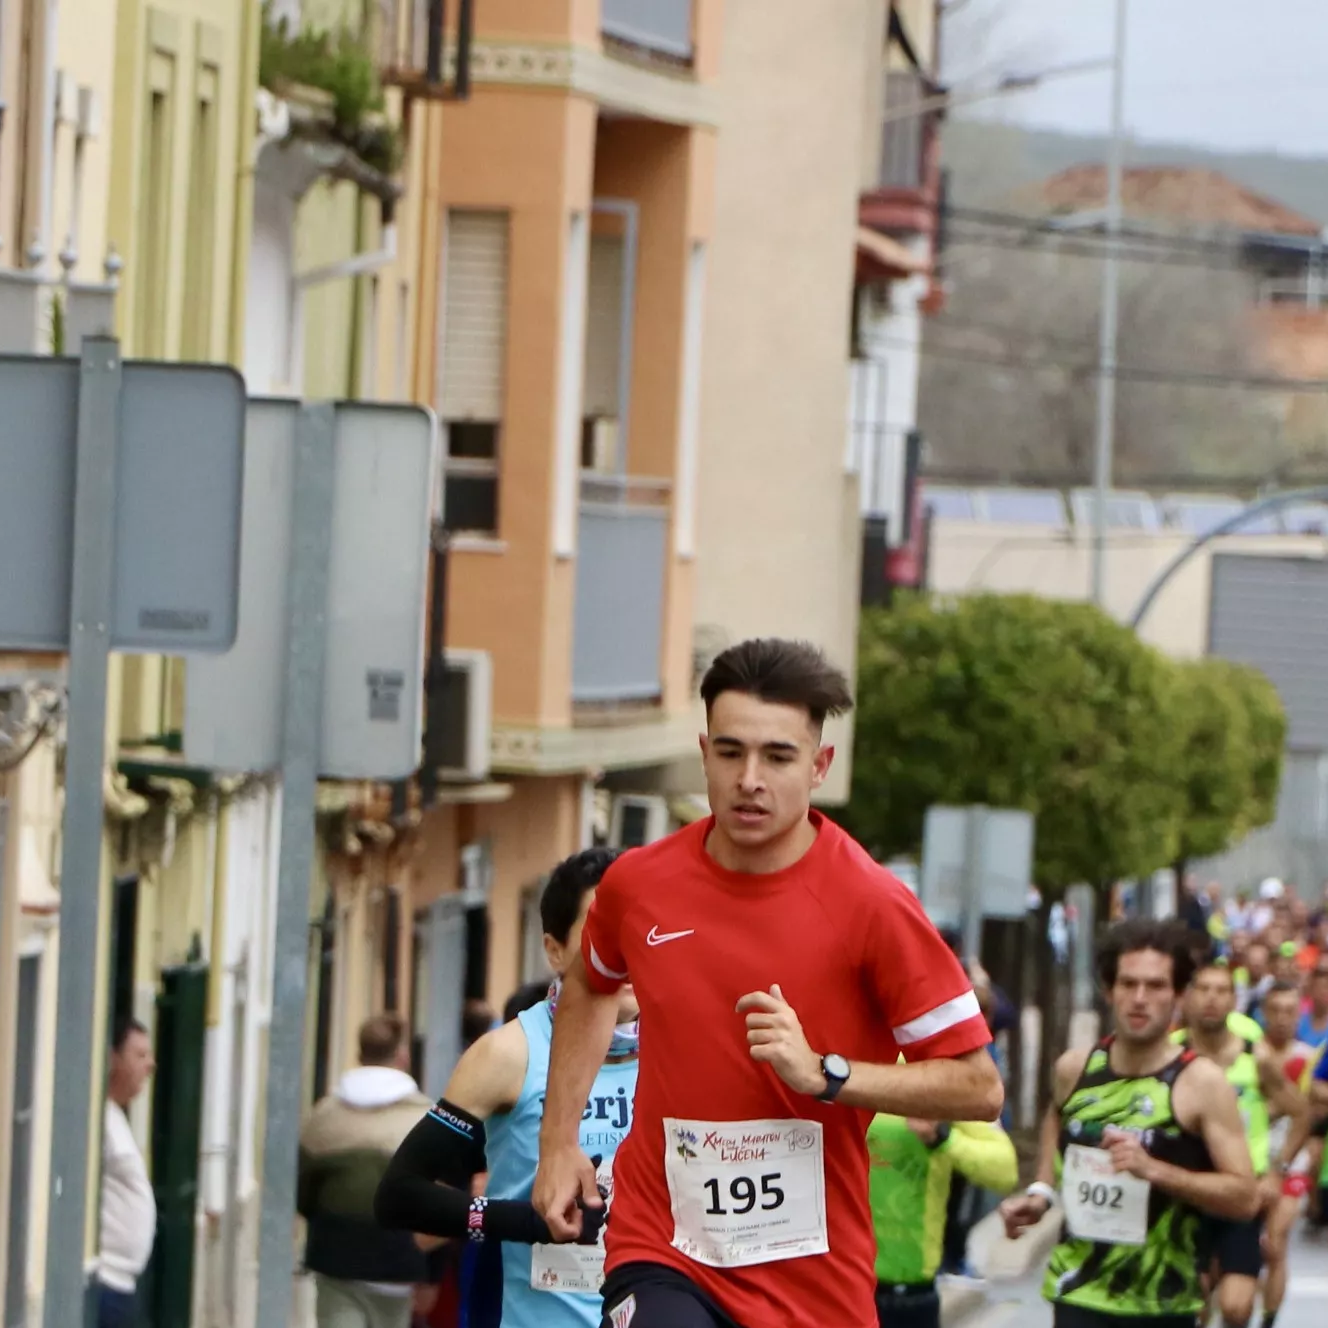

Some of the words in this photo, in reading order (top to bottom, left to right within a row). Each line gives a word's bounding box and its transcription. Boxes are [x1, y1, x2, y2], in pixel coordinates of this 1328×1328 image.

[721, 1147, 772, 1162] LUCENA
[703, 1172, 785, 1216] 195
[1078, 1180, 1124, 1209] 902
